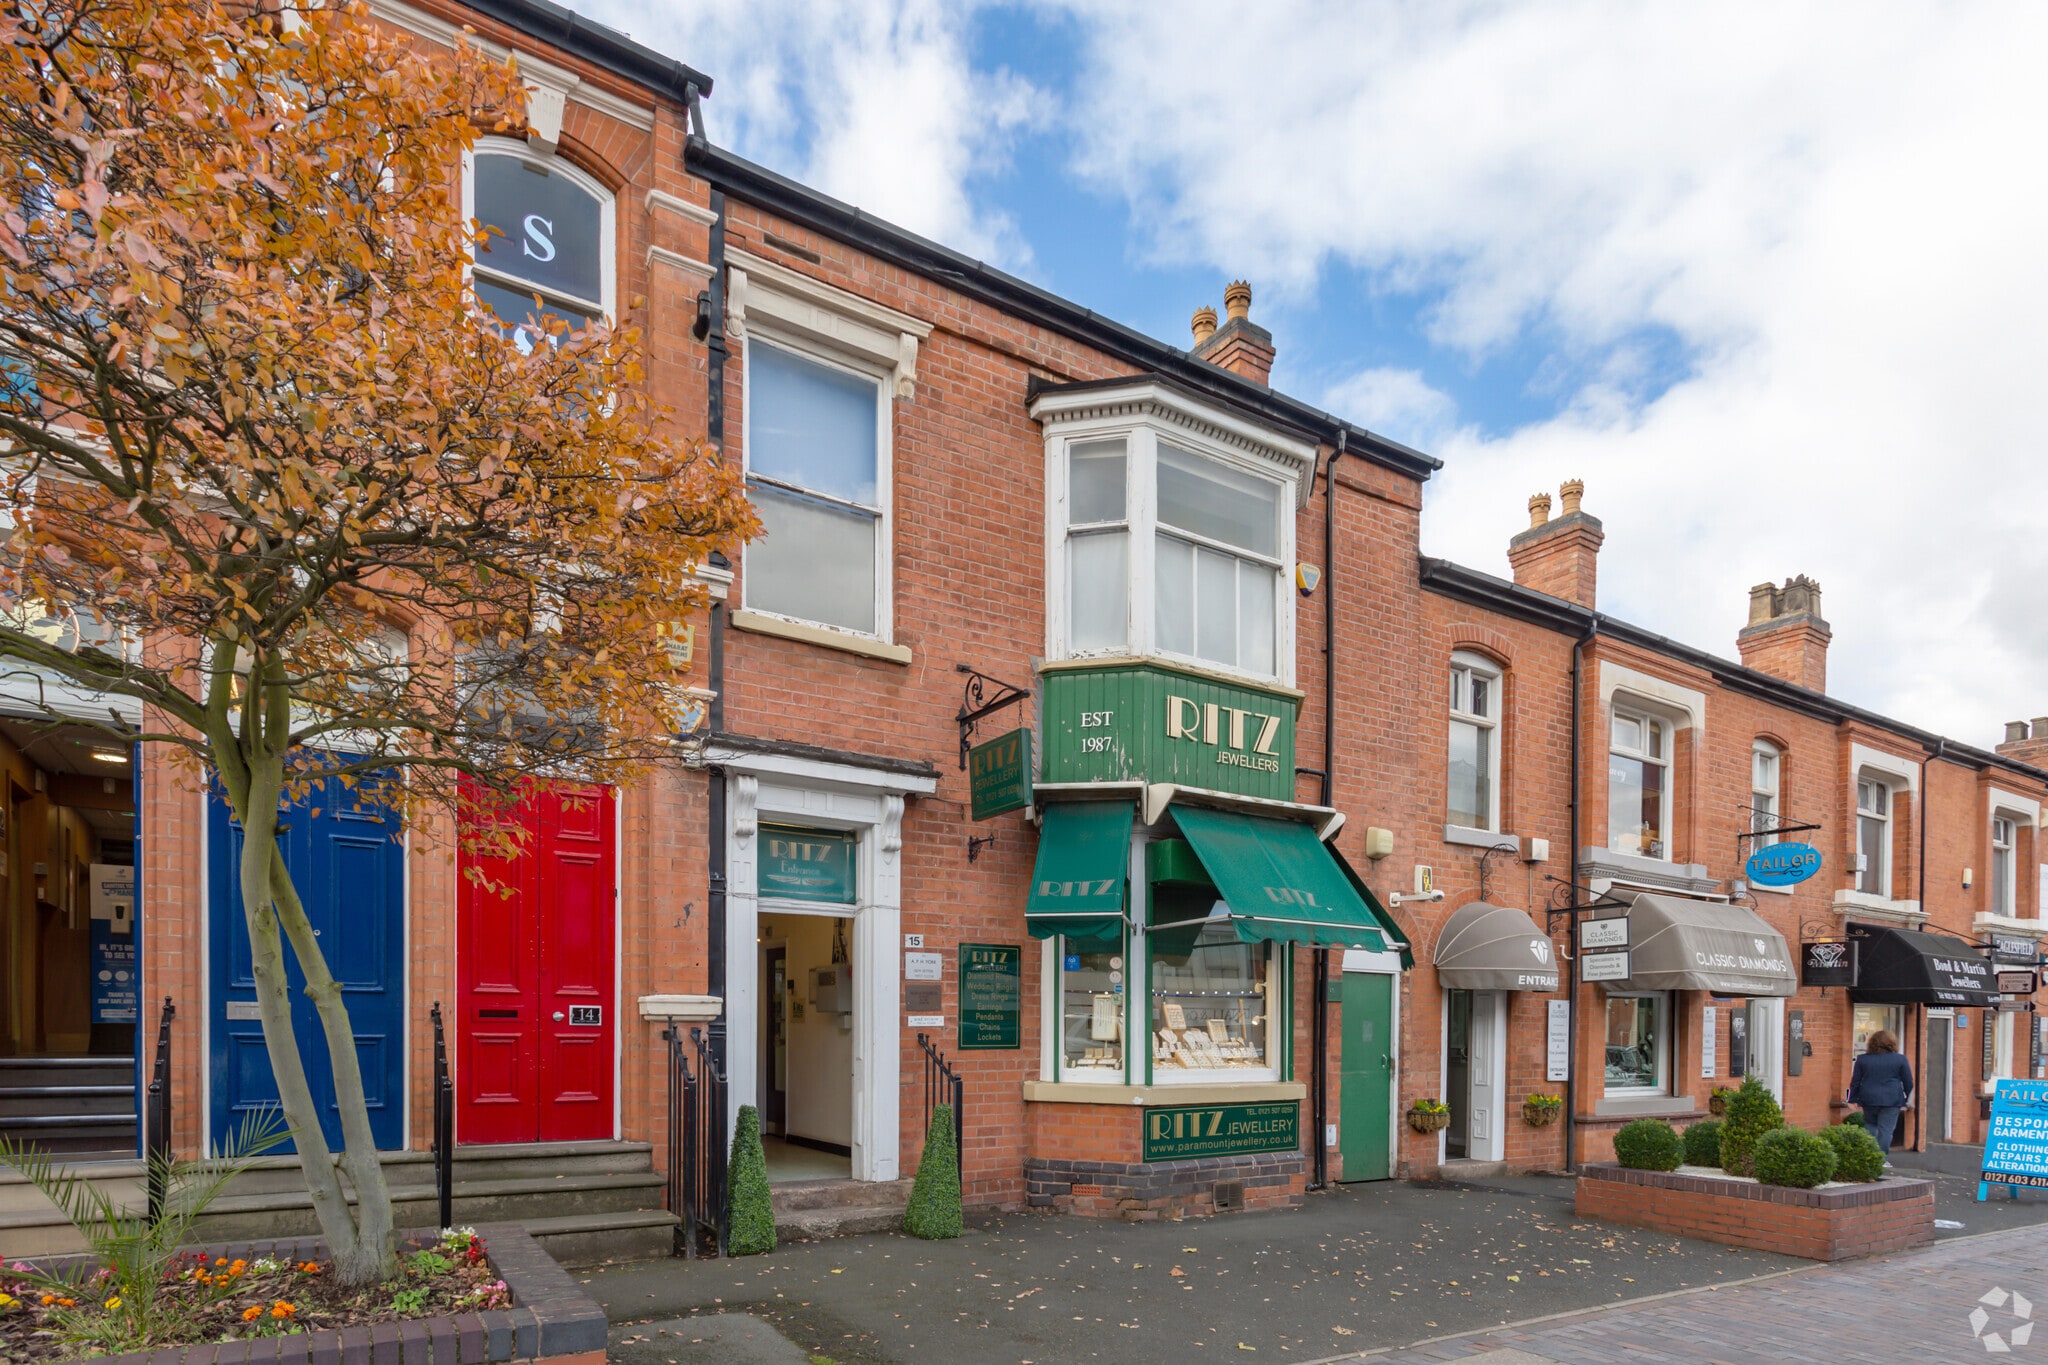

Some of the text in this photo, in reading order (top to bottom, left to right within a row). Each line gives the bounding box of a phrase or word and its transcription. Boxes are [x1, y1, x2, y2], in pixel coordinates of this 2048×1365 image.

[523, 214, 556, 263] S
[1080, 711, 1114, 728] EST
[1166, 694, 1281, 756] RITZ
[1081, 736, 1112, 753] 1987
[973, 740, 1017, 778] RITZ
[1216, 750, 1280, 773] JEWELLERS
[975, 766, 1019, 791] JEWELLERY
[769, 839, 832, 863] RITZ
[781, 860, 821, 875] Entrance
[1752, 853, 1816, 871] TAILOR
[1038, 879, 1116, 897] RITZ
[1263, 886, 1322, 908] RITZ
[909, 936, 920, 946] 15
[1586, 935, 1623, 945] DIAMONDS
[1590, 930, 1618, 938] CLASSIC
[971, 951, 1008, 963] RITZ
[1696, 952, 1787, 972] CLASSIC DIAMONDS
[1933, 958, 1987, 975] Bond & Martin
[1950, 974, 1981, 989] Jewellers
[991, 993, 1009, 1002] Rings
[579, 1008, 595, 1020] 14
[976, 1012, 1004, 1020] Pendants
[979, 1022, 1001, 1031] Chains
[978, 1033, 1002, 1041] Lockets
[1151, 1111, 1224, 1140] RITZ
[1227, 1119, 1294, 1136] JEWELLERY
[1150, 1134, 1294, 1153] www.paramountjewellery.co.uk
[1992, 1151, 2041, 1164] REPAIRS
[1987, 1160, 2048, 1173] ALTERATION
[1984, 1172, 2007, 1182] 0121
[2008, 1174, 2028, 1185] 603
